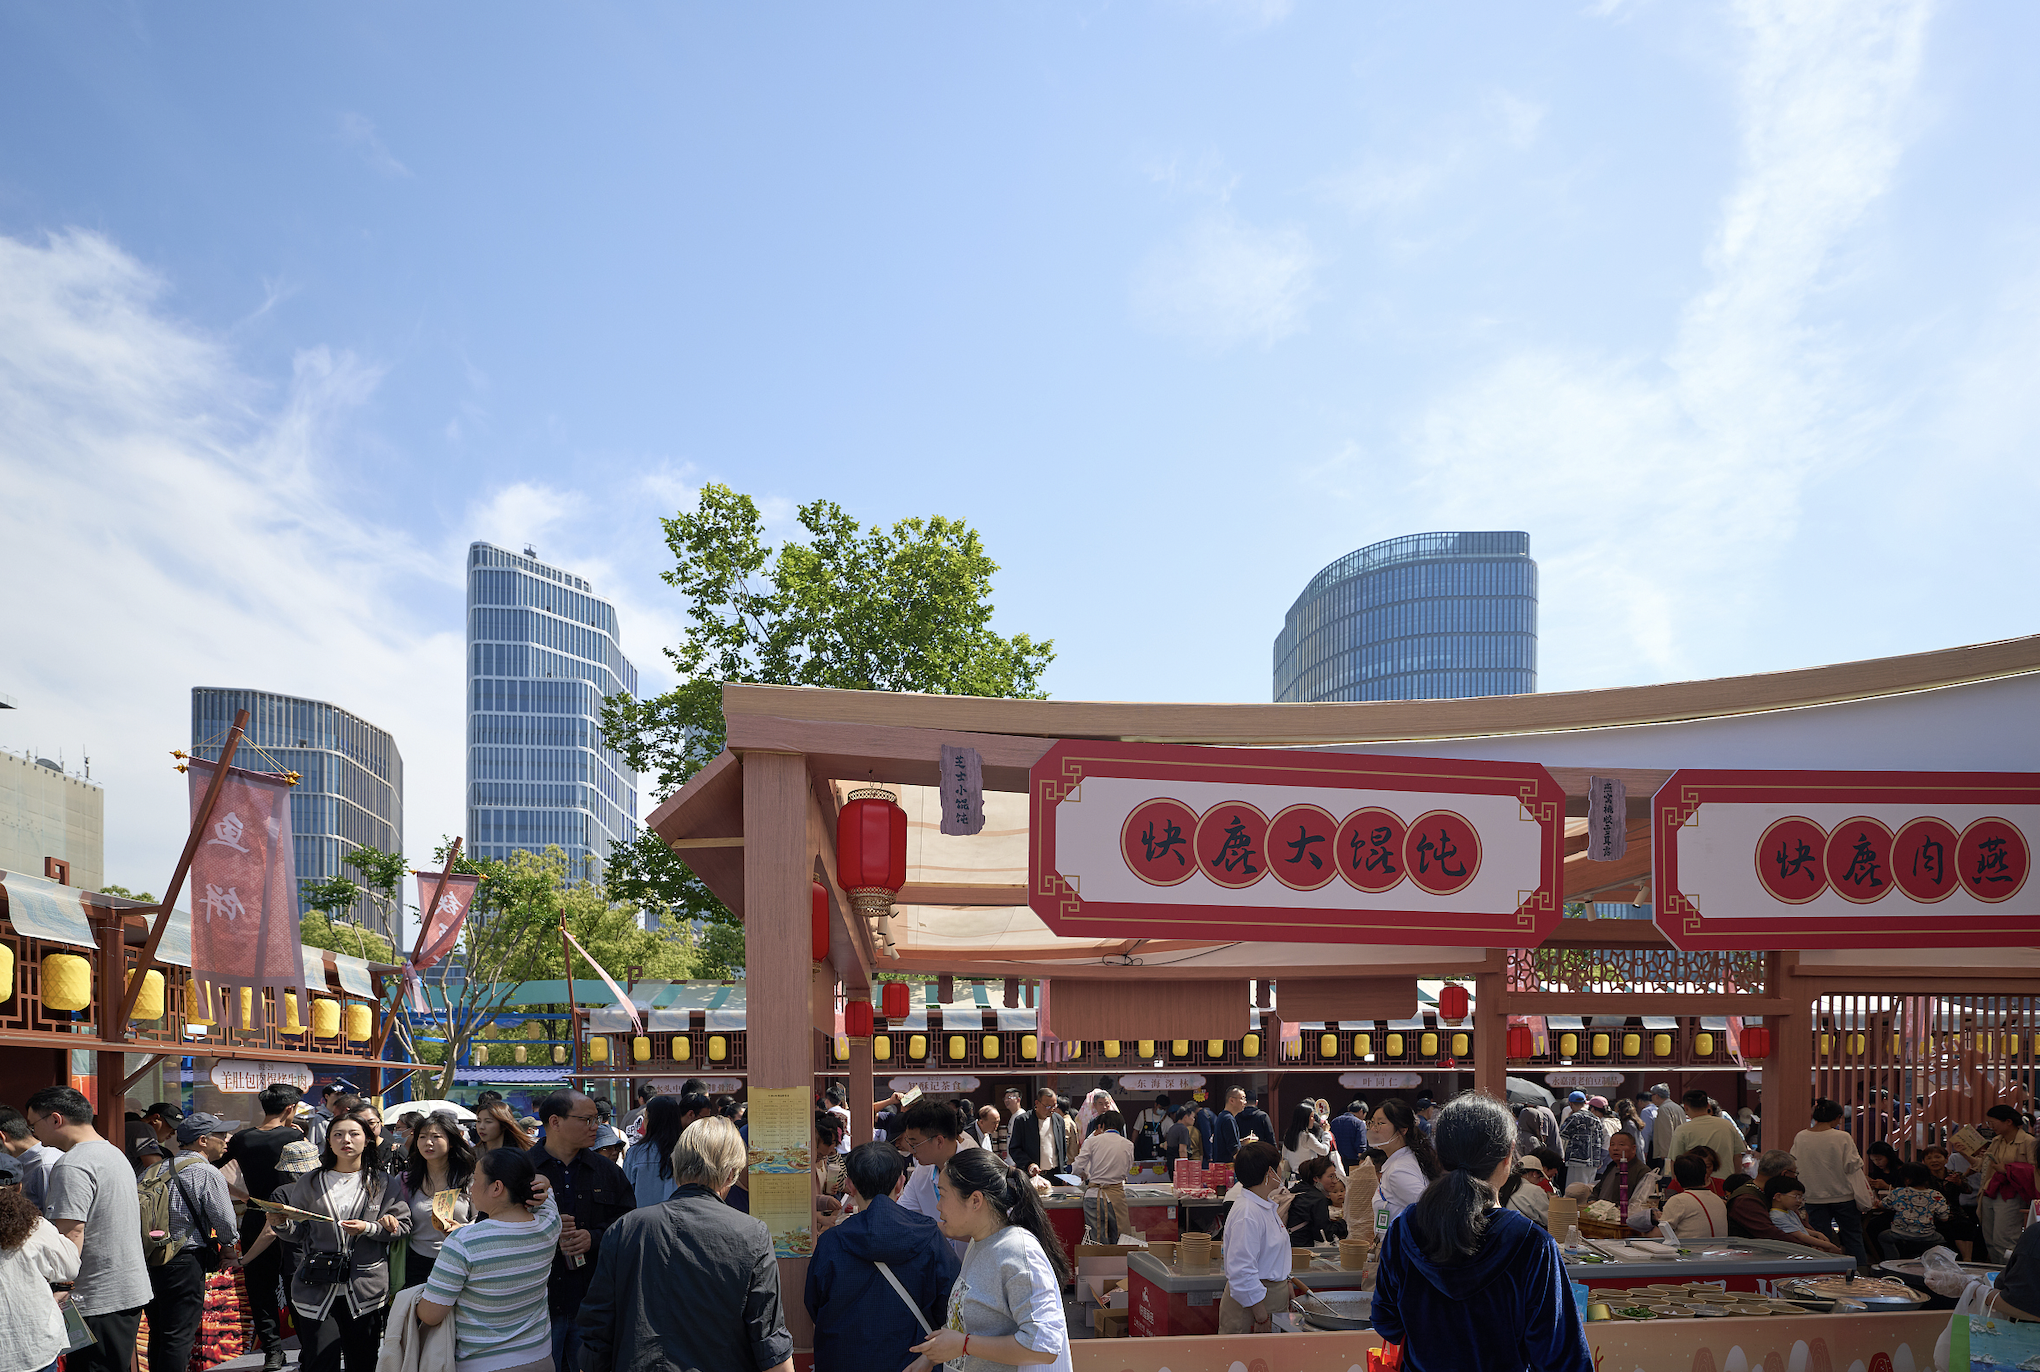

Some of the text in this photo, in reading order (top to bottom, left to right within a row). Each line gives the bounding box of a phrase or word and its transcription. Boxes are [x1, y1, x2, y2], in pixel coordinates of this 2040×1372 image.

[954, 755, 970, 825] 芝士小馄饨
[1140, 815, 1468, 877] 快鹿大馄饨
[1775, 832, 2014, 887] 快鹿肉燕
[1136, 1078, 1190, 1089] 东海深林
[1362, 1077, 1398, 1087] 叶同仁
